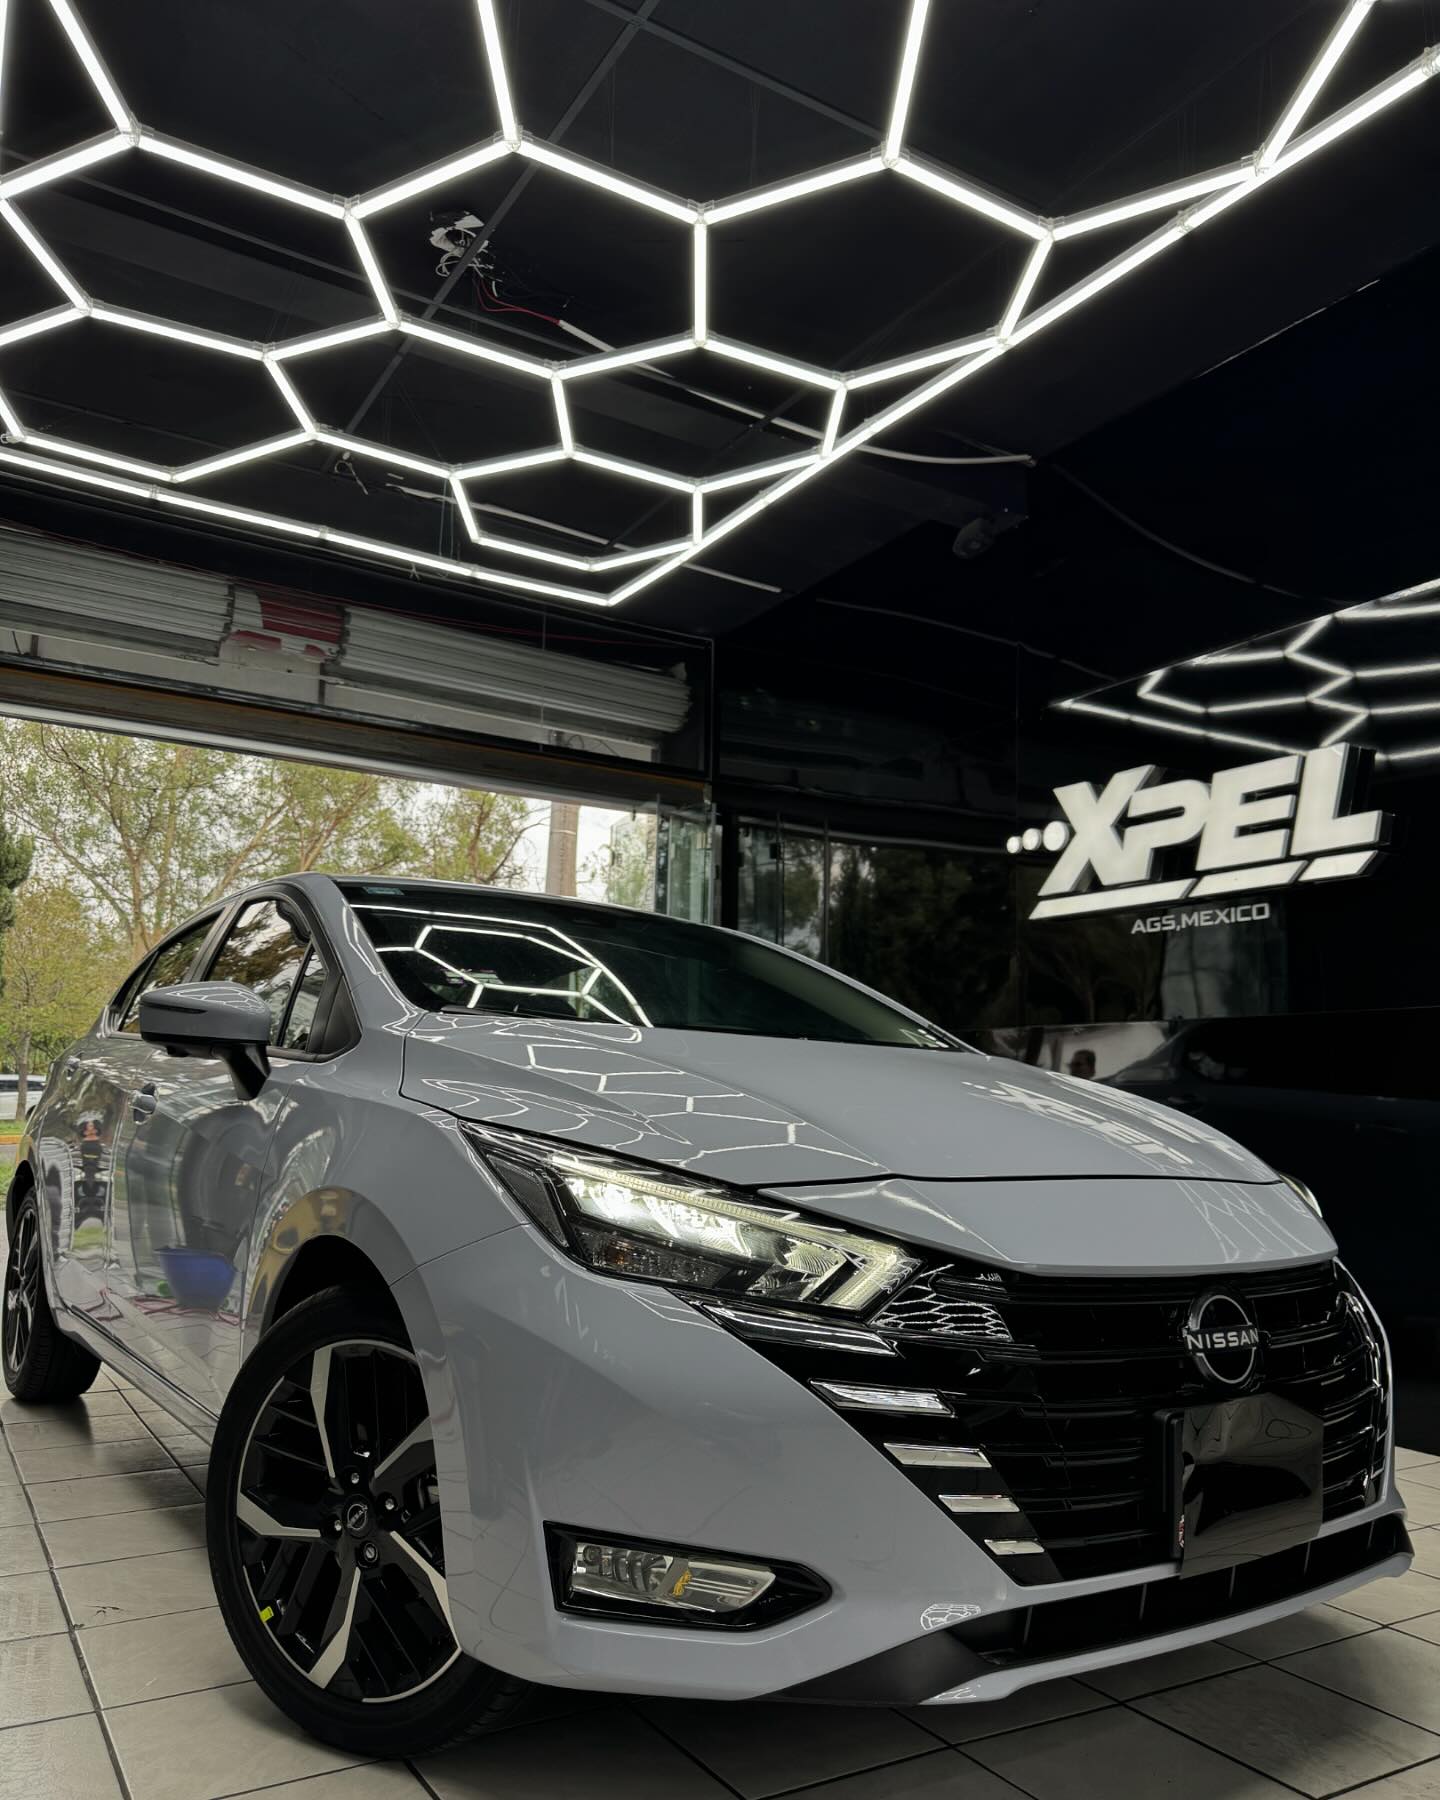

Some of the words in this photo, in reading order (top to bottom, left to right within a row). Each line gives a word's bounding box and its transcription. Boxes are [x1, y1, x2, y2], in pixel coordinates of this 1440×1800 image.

[1037, 742, 1385, 897] XPEL
[1130, 903, 1271, 935] AGS,MEXICO
[1186, 1328, 1259, 1349] NISSAN
